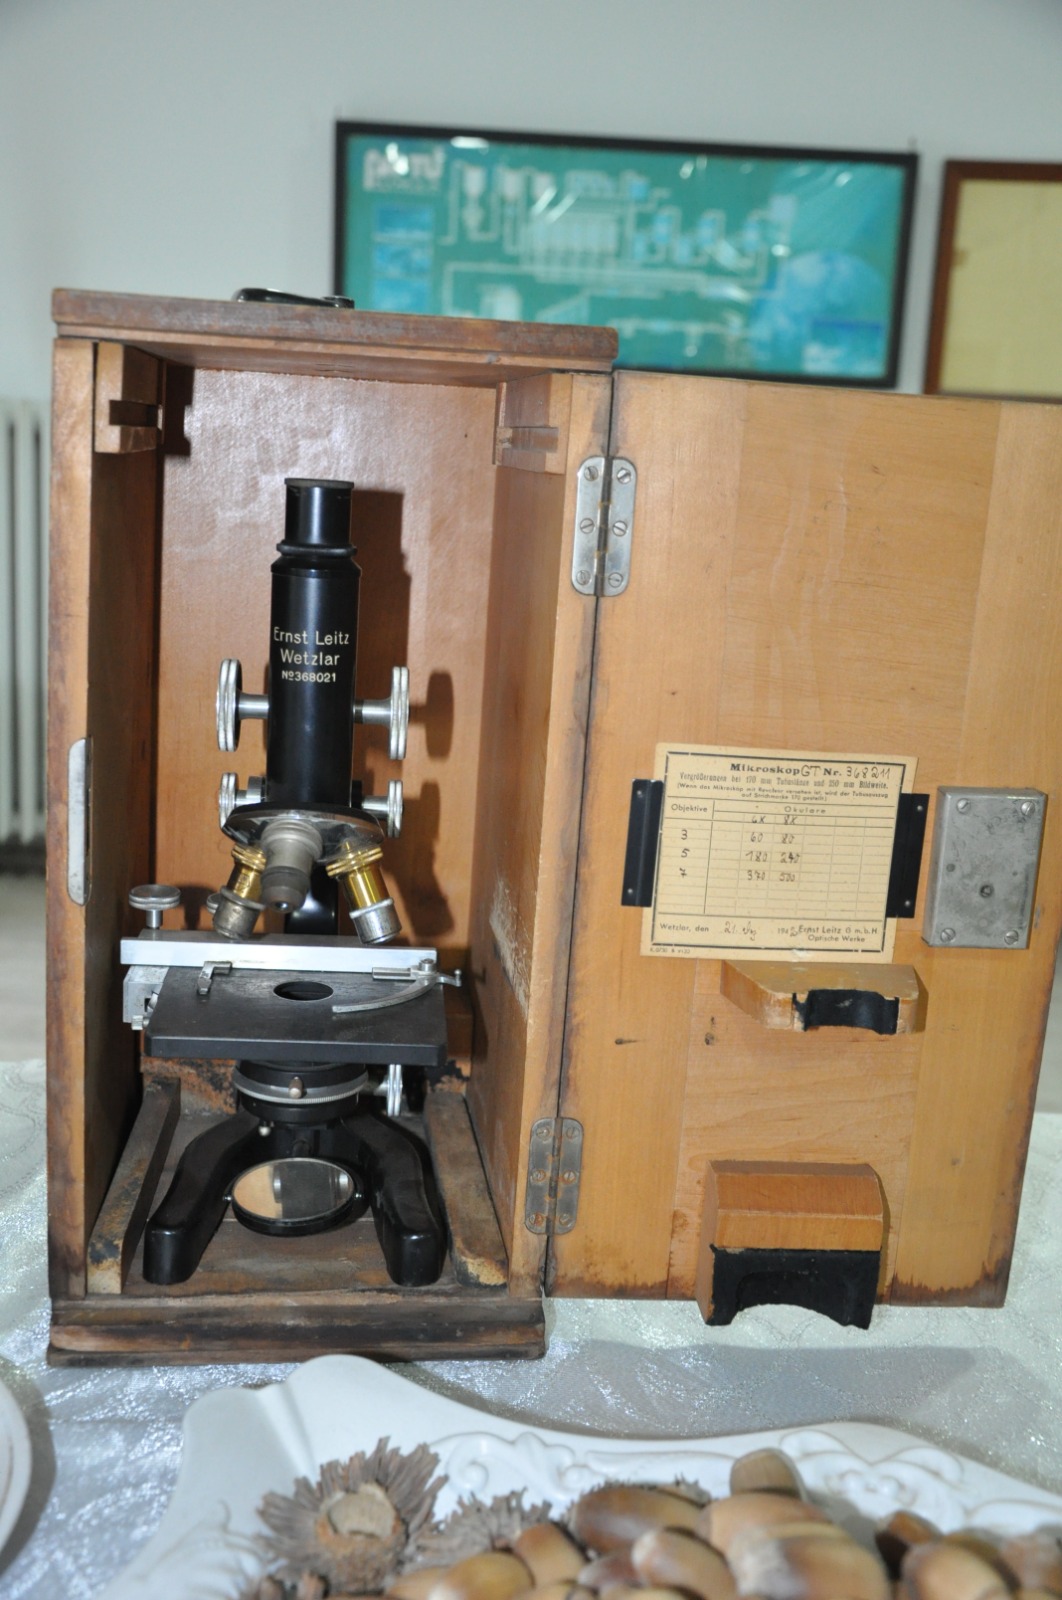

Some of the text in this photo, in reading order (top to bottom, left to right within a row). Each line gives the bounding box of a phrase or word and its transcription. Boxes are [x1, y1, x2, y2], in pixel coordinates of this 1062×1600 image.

[273, 626, 350, 646] Ernst Leitz
[280, 648, 341, 666] Wetzlar
[730, 763, 800, 776] Mikroskop
[823, 767, 842, 777] Nr.
[671, 804, 708, 813] Objektive
[784, 806, 827, 814] Okulare
[681, 829, 688, 841] 3
[681, 848, 690, 858] 5
[660, 923, 691, 933] Wetzlar,
[798, 924, 819, 934] Ernst
[822, 925, 842, 934] Leitz
[807, 934, 866, 943] Optische Werke
